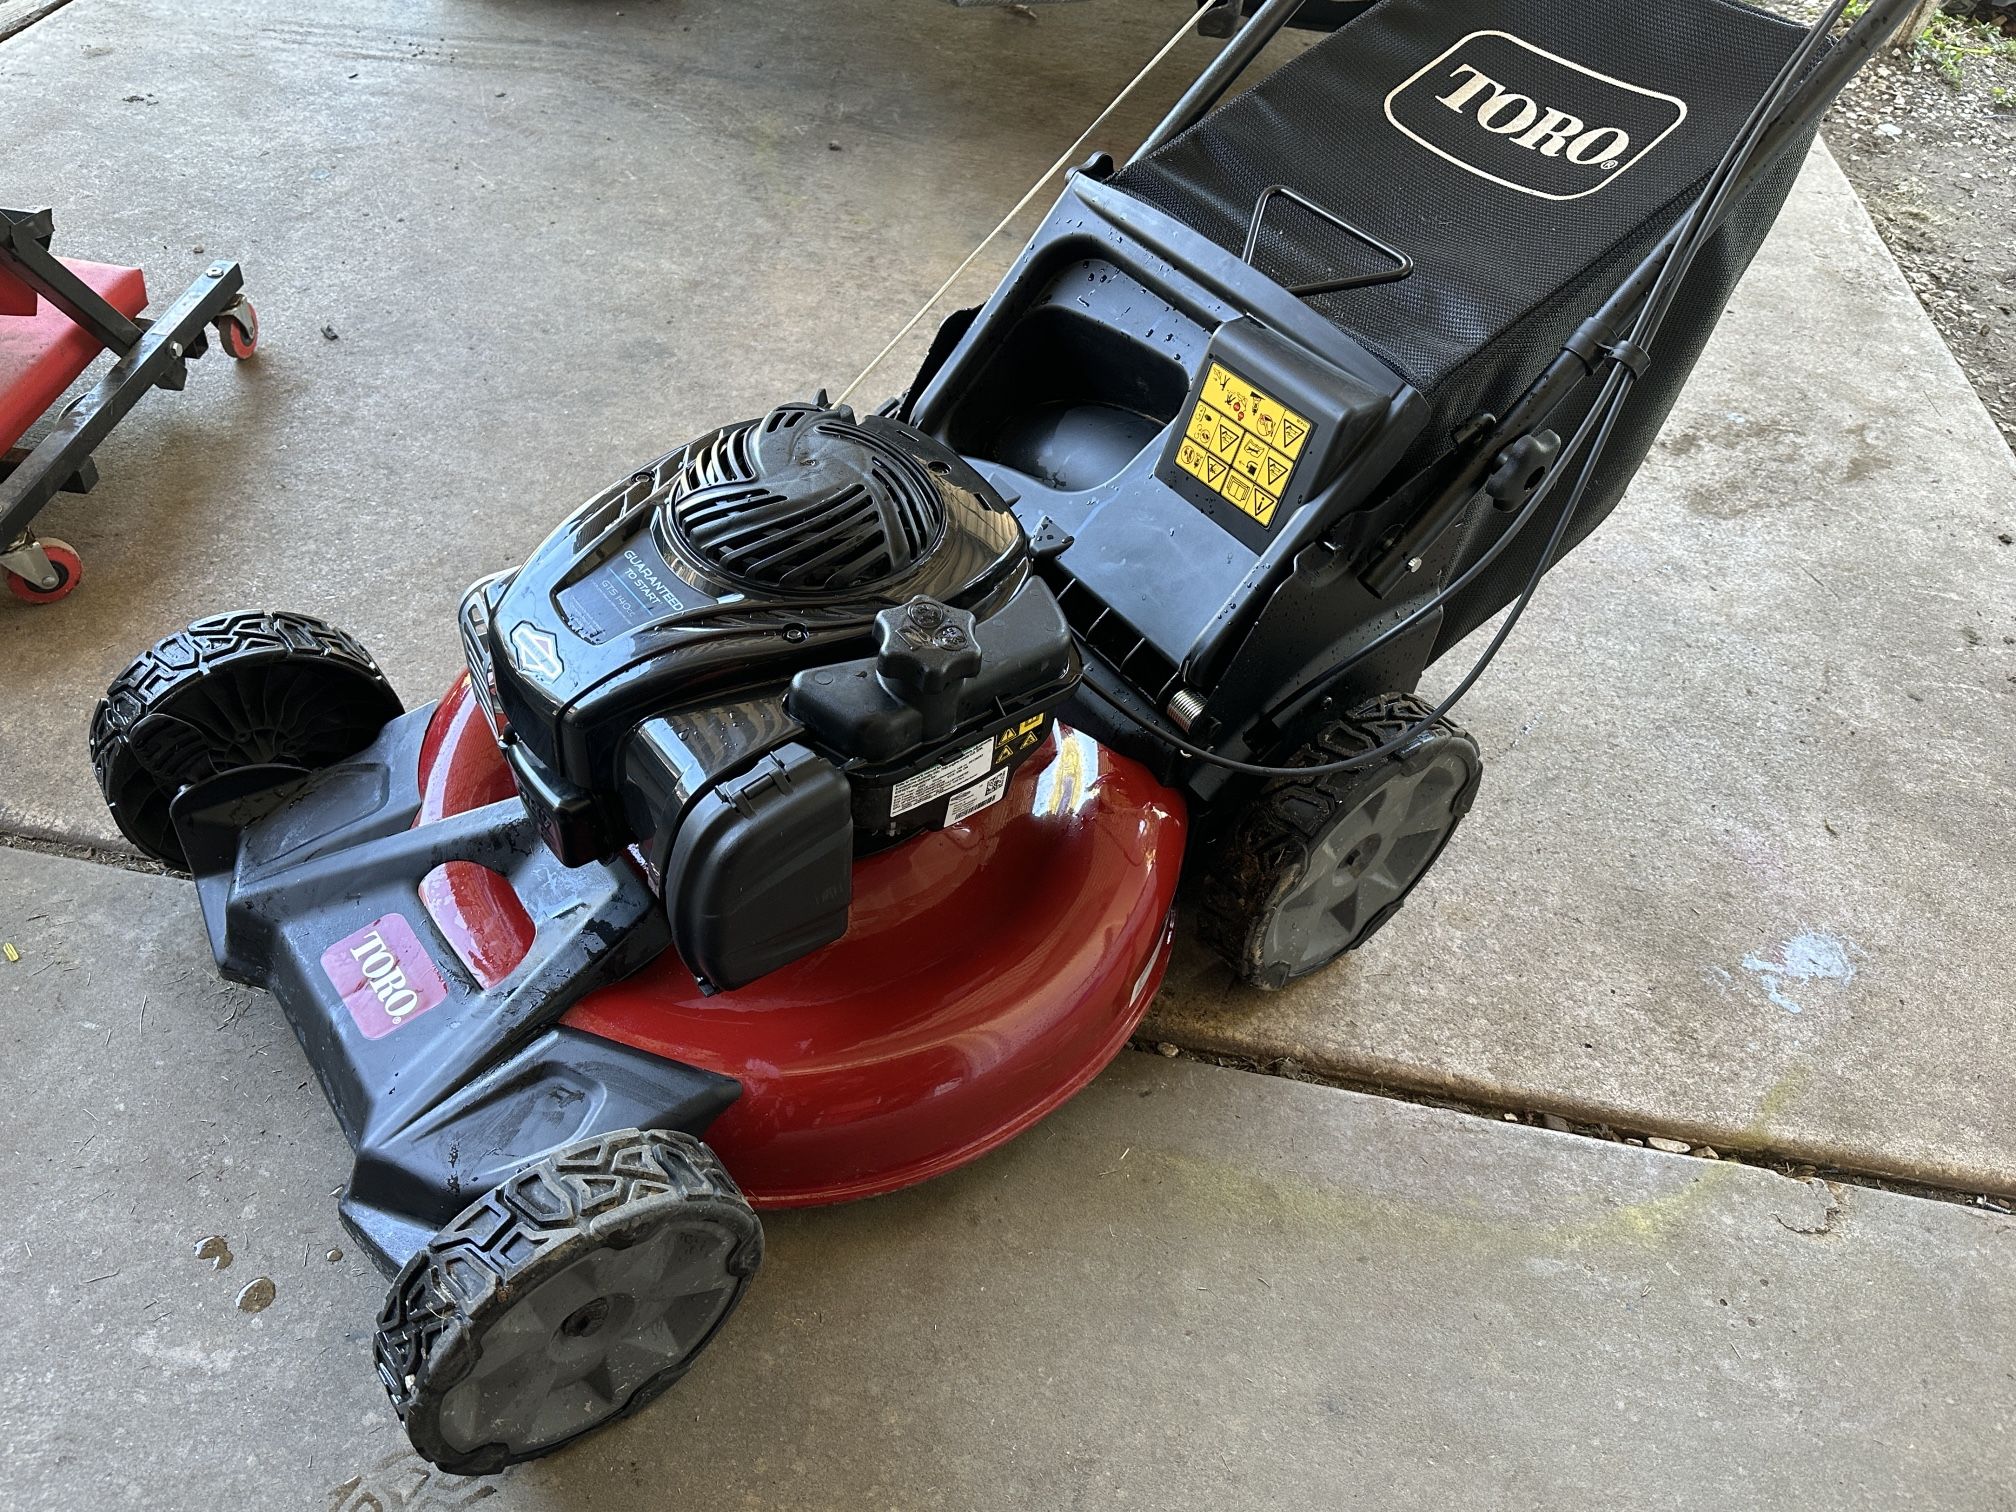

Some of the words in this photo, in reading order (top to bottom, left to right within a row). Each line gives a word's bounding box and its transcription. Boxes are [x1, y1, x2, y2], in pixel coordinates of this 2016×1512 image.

[623, 550, 684, 611] GUARANTEED
[625, 567, 638, 581] TO
[601, 580, 619, 597] GTS
